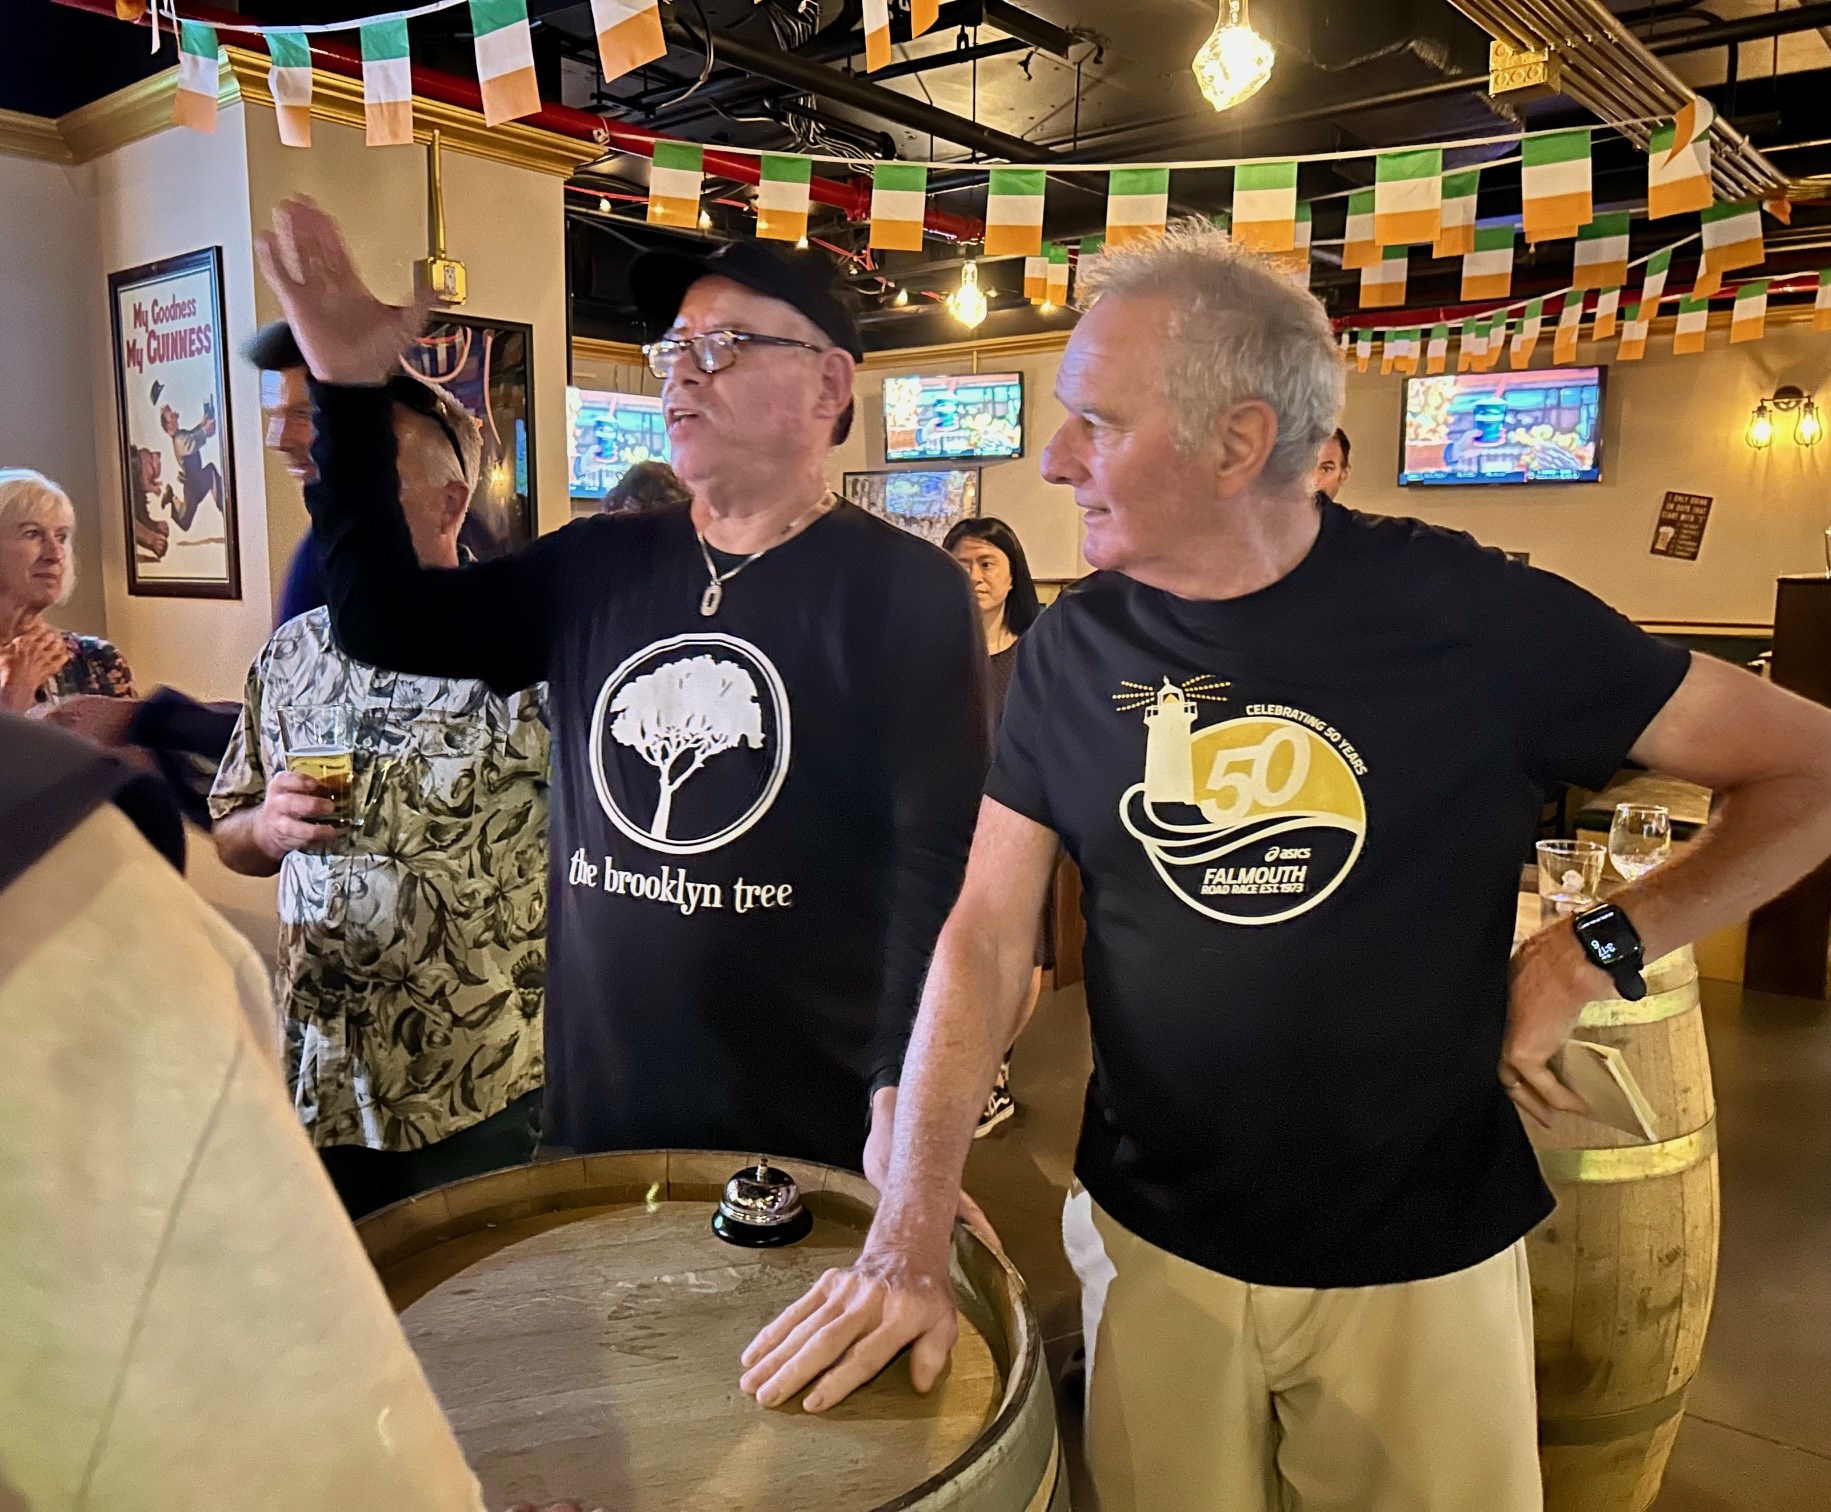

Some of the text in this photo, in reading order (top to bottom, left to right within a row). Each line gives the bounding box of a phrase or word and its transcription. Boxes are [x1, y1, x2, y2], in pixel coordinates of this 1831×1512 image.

[133, 294, 197, 333] My Goodness
[126, 323, 212, 374] My GUINNESS
[1246, 704, 1369, 776] CELEBRATING 50 YEARS
[1201, 726, 1311, 825] 50
[1203, 866, 1308, 885] FALMOUTH
[1280, 848, 1311, 860] asics
[569, 848, 794, 915] the brooklyn tree
[1201, 885, 1231, 895] ROAD
[1231, 884, 1259, 895] RACE
